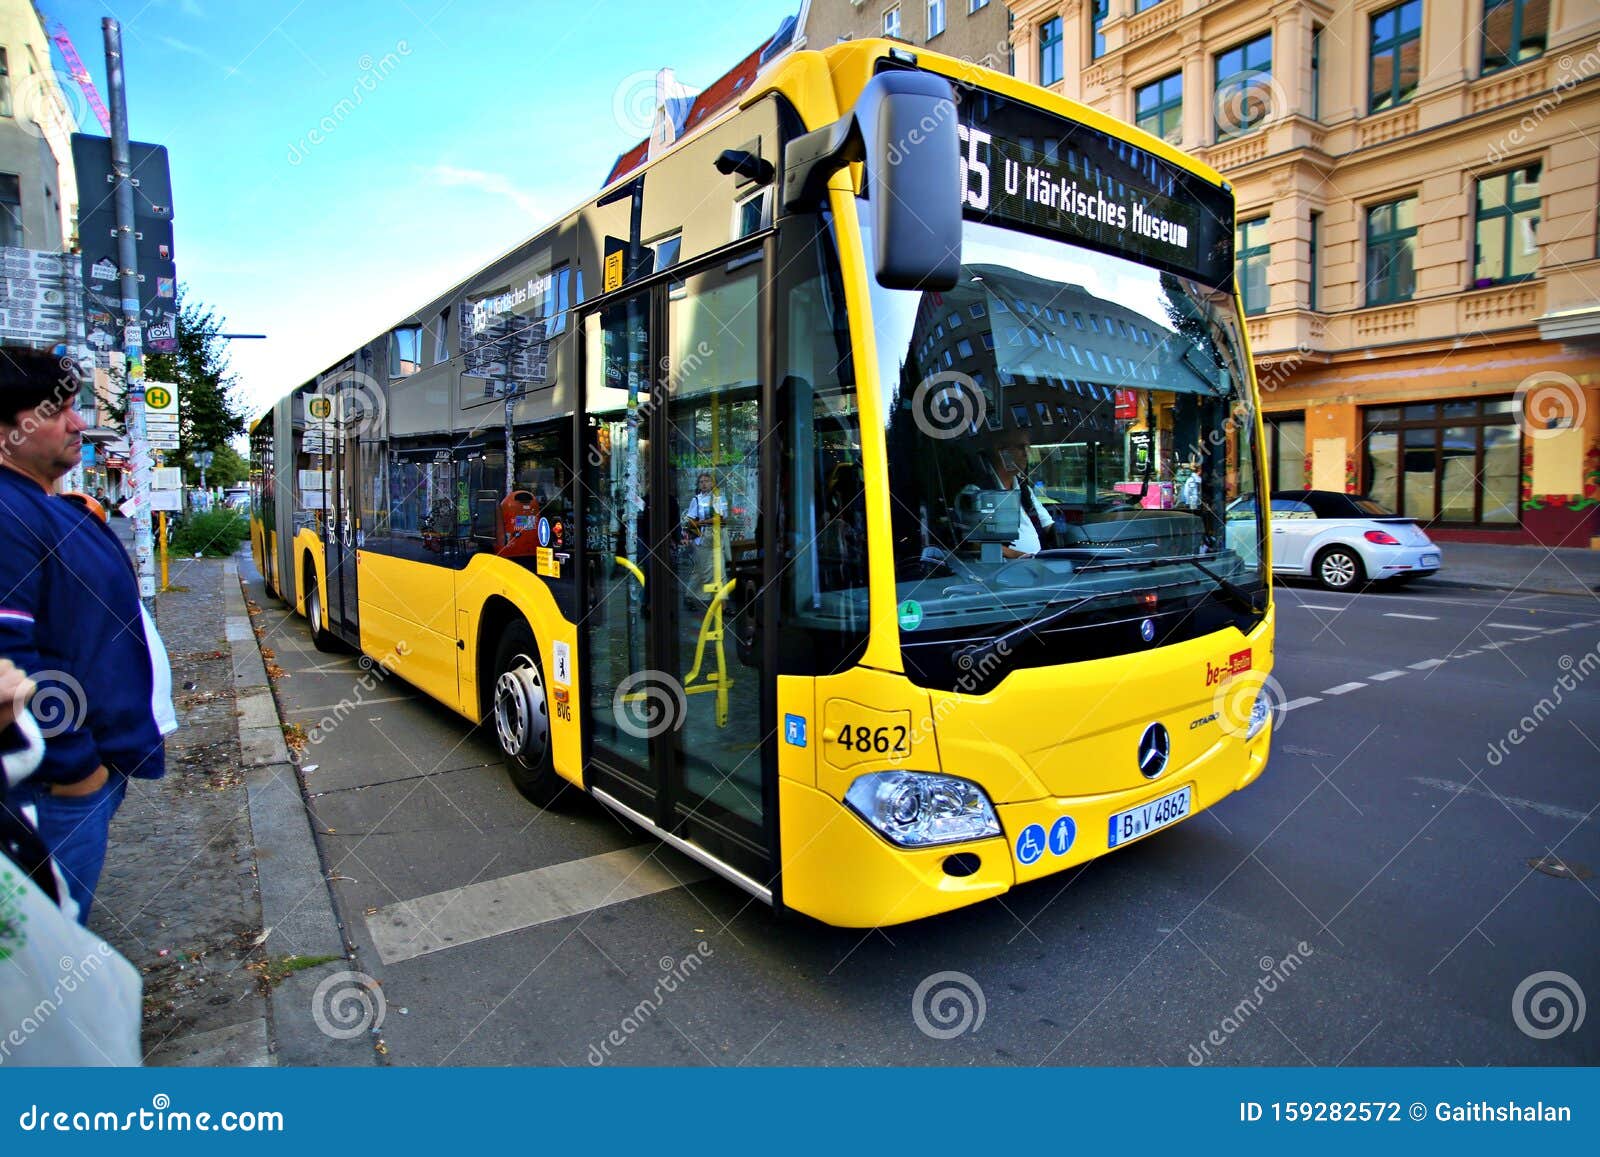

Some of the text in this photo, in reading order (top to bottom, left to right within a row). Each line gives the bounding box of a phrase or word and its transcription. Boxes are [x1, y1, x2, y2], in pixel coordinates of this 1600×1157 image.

[1005, 158, 1018, 195] U
[1026, 166, 1127, 229] Märkisches
[1132, 203, 1188, 248] Museum
[151, 391, 164, 404] H
[906, 602, 914, 615] 4
[557, 702, 571, 722] BVG
[837, 724, 907, 753] 4862
[1123, 792, 1185, 838] B V 4862
